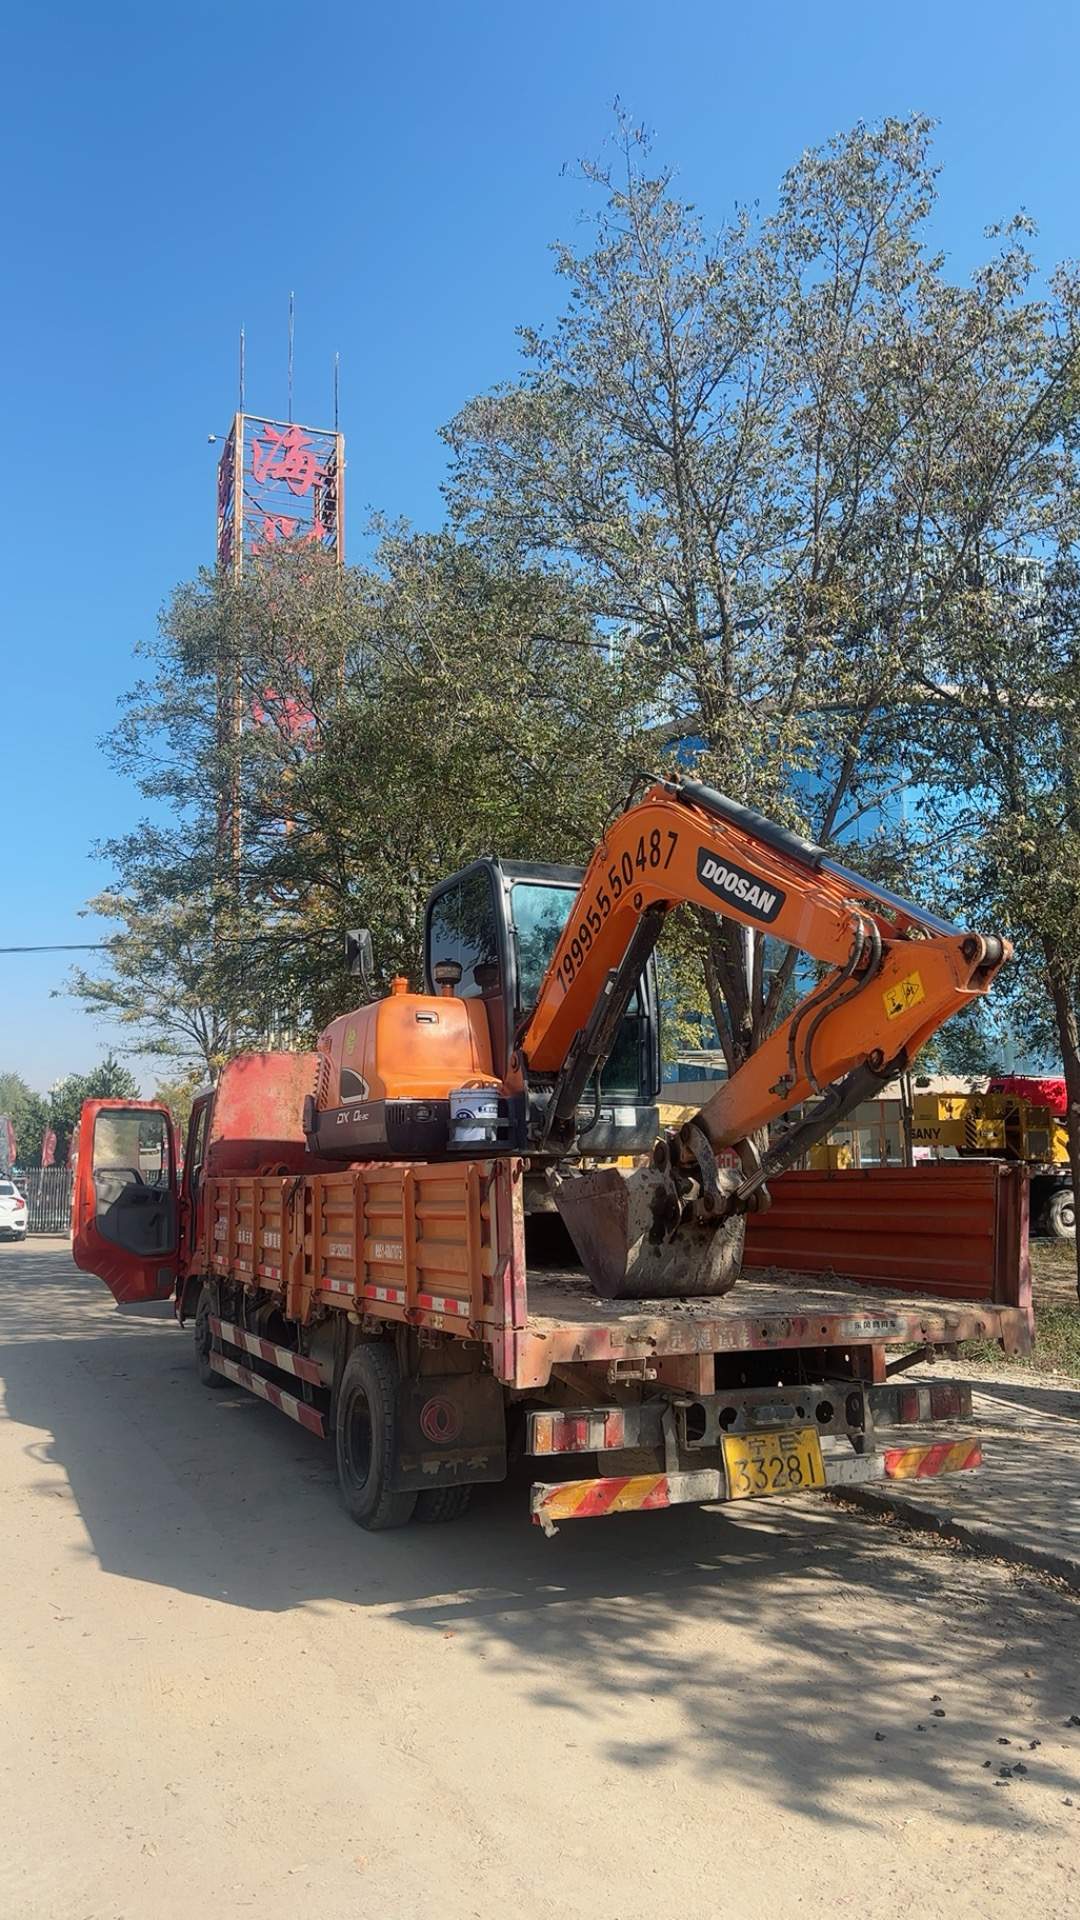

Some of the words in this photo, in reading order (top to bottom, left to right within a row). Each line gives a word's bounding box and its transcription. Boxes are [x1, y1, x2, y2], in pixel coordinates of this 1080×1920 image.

[555, 828, 679, 994] 19995550487
[701, 858, 777, 915] DOOSAN
[735, 1452, 816, 1492] 33281
